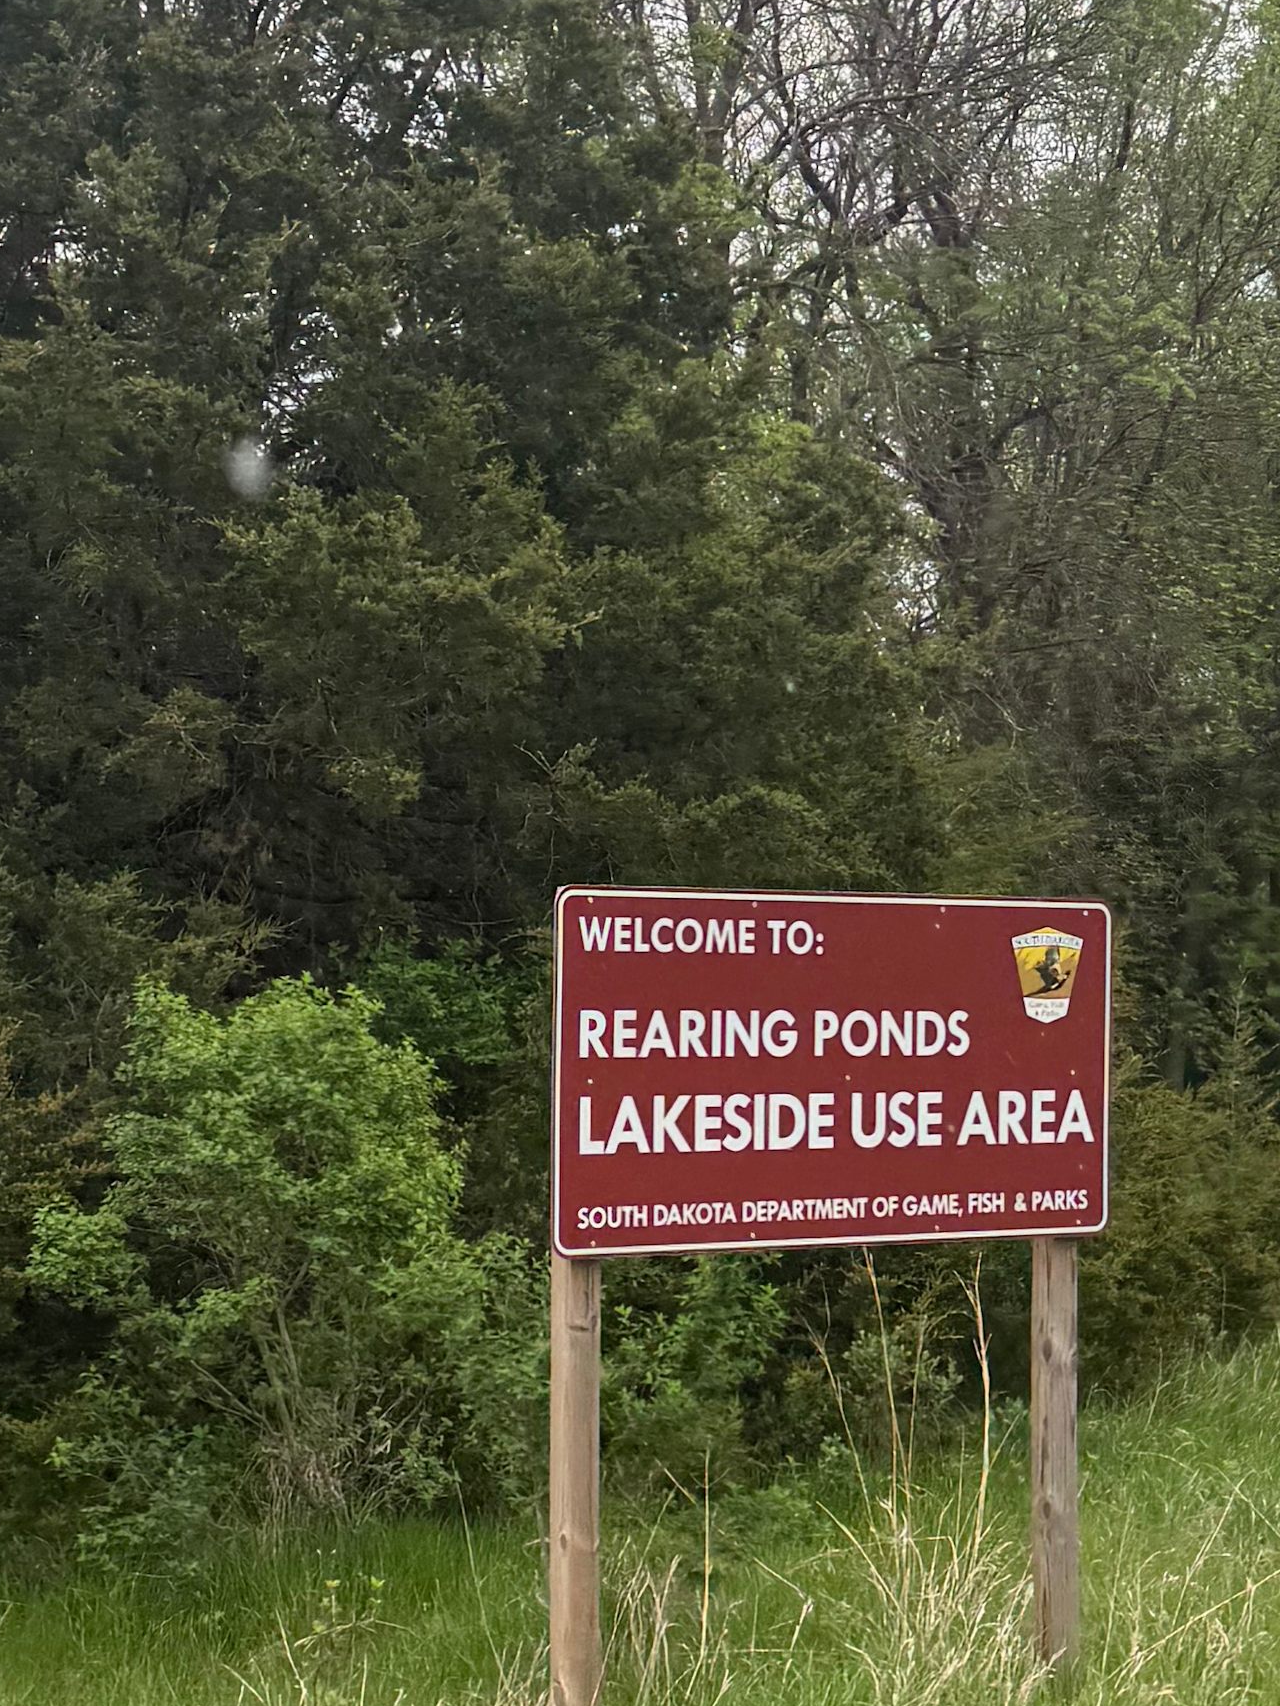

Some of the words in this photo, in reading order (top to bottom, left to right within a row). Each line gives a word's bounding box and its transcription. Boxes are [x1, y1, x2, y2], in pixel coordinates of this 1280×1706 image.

[579, 917, 755, 954] WELCOME
[767, 921, 824, 954] TO:
[580, 1010, 797, 1058] REARING
[815, 1010, 969, 1056] PONDS
[579, 1093, 834, 1154] LAKESIDE
[852, 1092, 942, 1148] USE
[957, 1090, 1094, 1145] AREA
[578, 1205, 647, 1229] SOUTH
[654, 1203, 737, 1226] DAKOTA
[742, 1197, 868, 1222] DEPARTMENT
[872, 1196, 898, 1217] OF
[903, 1194, 963, 1217] GAME,
[968, 1193, 1004, 1214] FISH
[1014, 1193, 1027, 1211] &
[1032, 1190, 1088, 1211] PARKS
